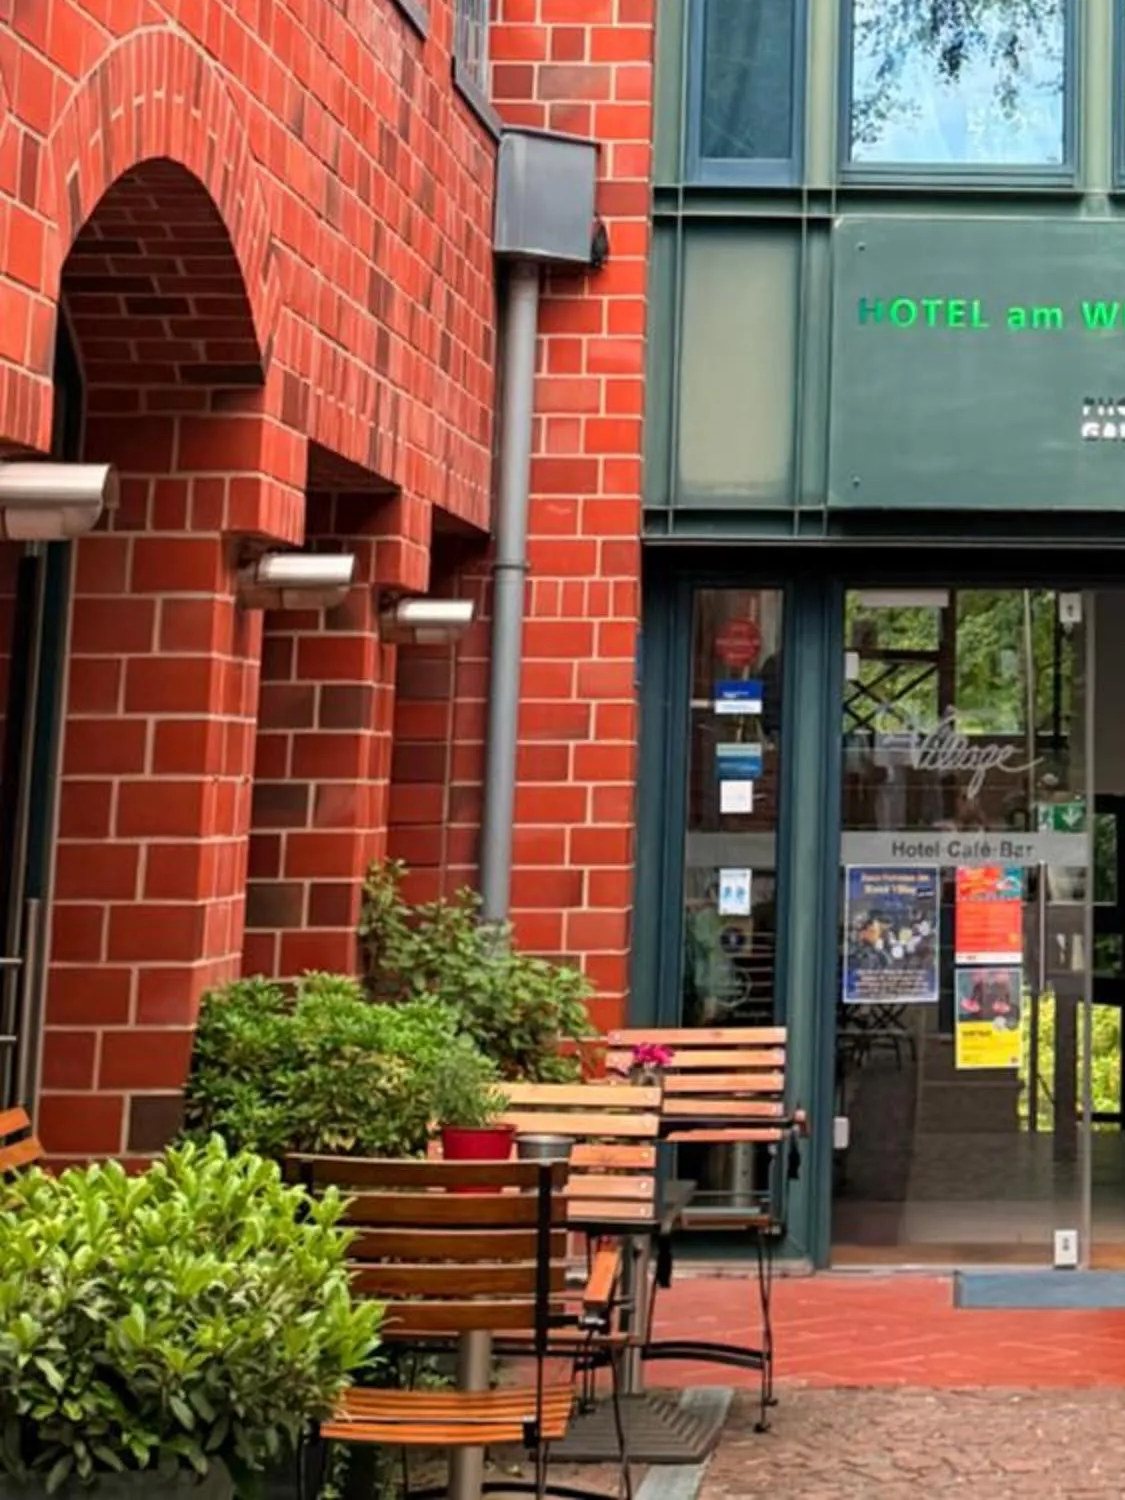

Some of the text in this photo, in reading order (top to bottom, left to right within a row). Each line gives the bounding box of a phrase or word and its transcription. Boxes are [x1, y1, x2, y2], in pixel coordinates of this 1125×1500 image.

[857, 297, 991, 329] HOTEL
[1007, 306, 1064, 330] am
[882, 705, 1044, 799] Village
[892, 841, 940, 857] Hotel
